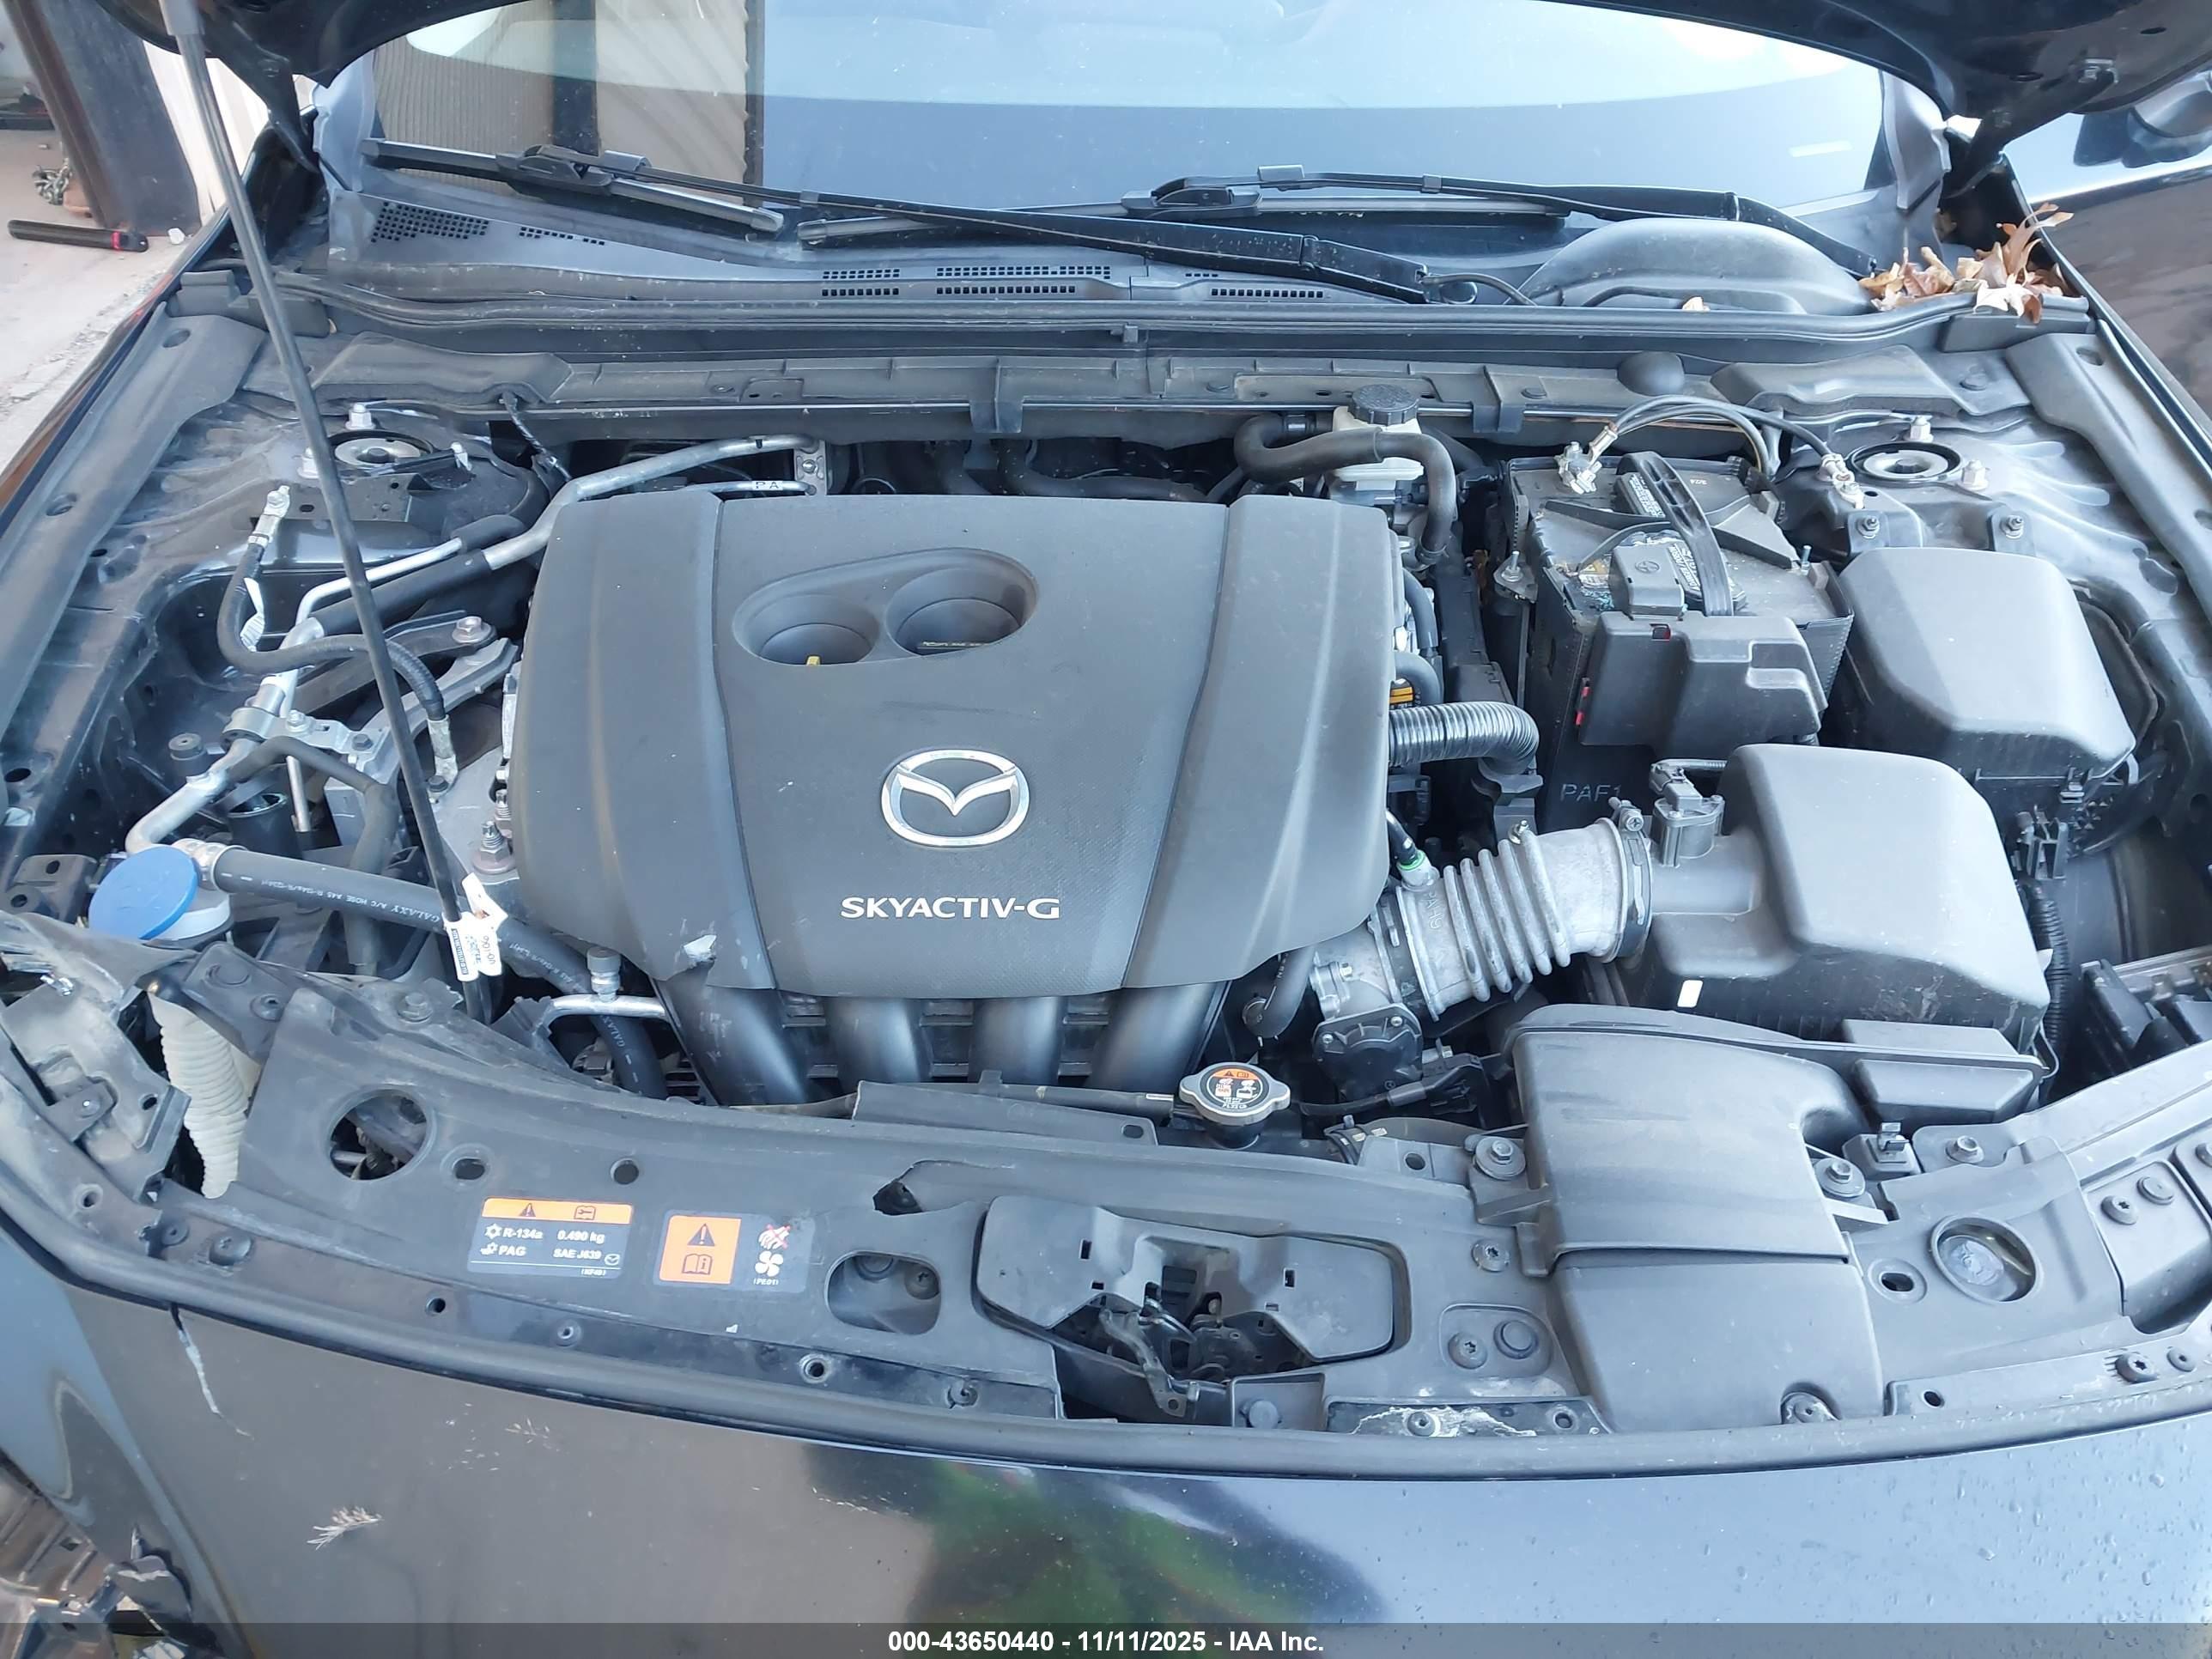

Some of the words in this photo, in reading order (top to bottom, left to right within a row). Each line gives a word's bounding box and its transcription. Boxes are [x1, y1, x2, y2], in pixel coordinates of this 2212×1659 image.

[370, 900, 388, 909] A/C
[841, 896, 1060, 920] SKYACTIV-G
[391, 905, 441, 922] GALAXY
[502, 1227, 544, 1240] R-134a
[589, 1231, 605, 1244] kg
[498, 1245, 526, 1256] PAG
[553, 1248, 576, 1259] SAE
